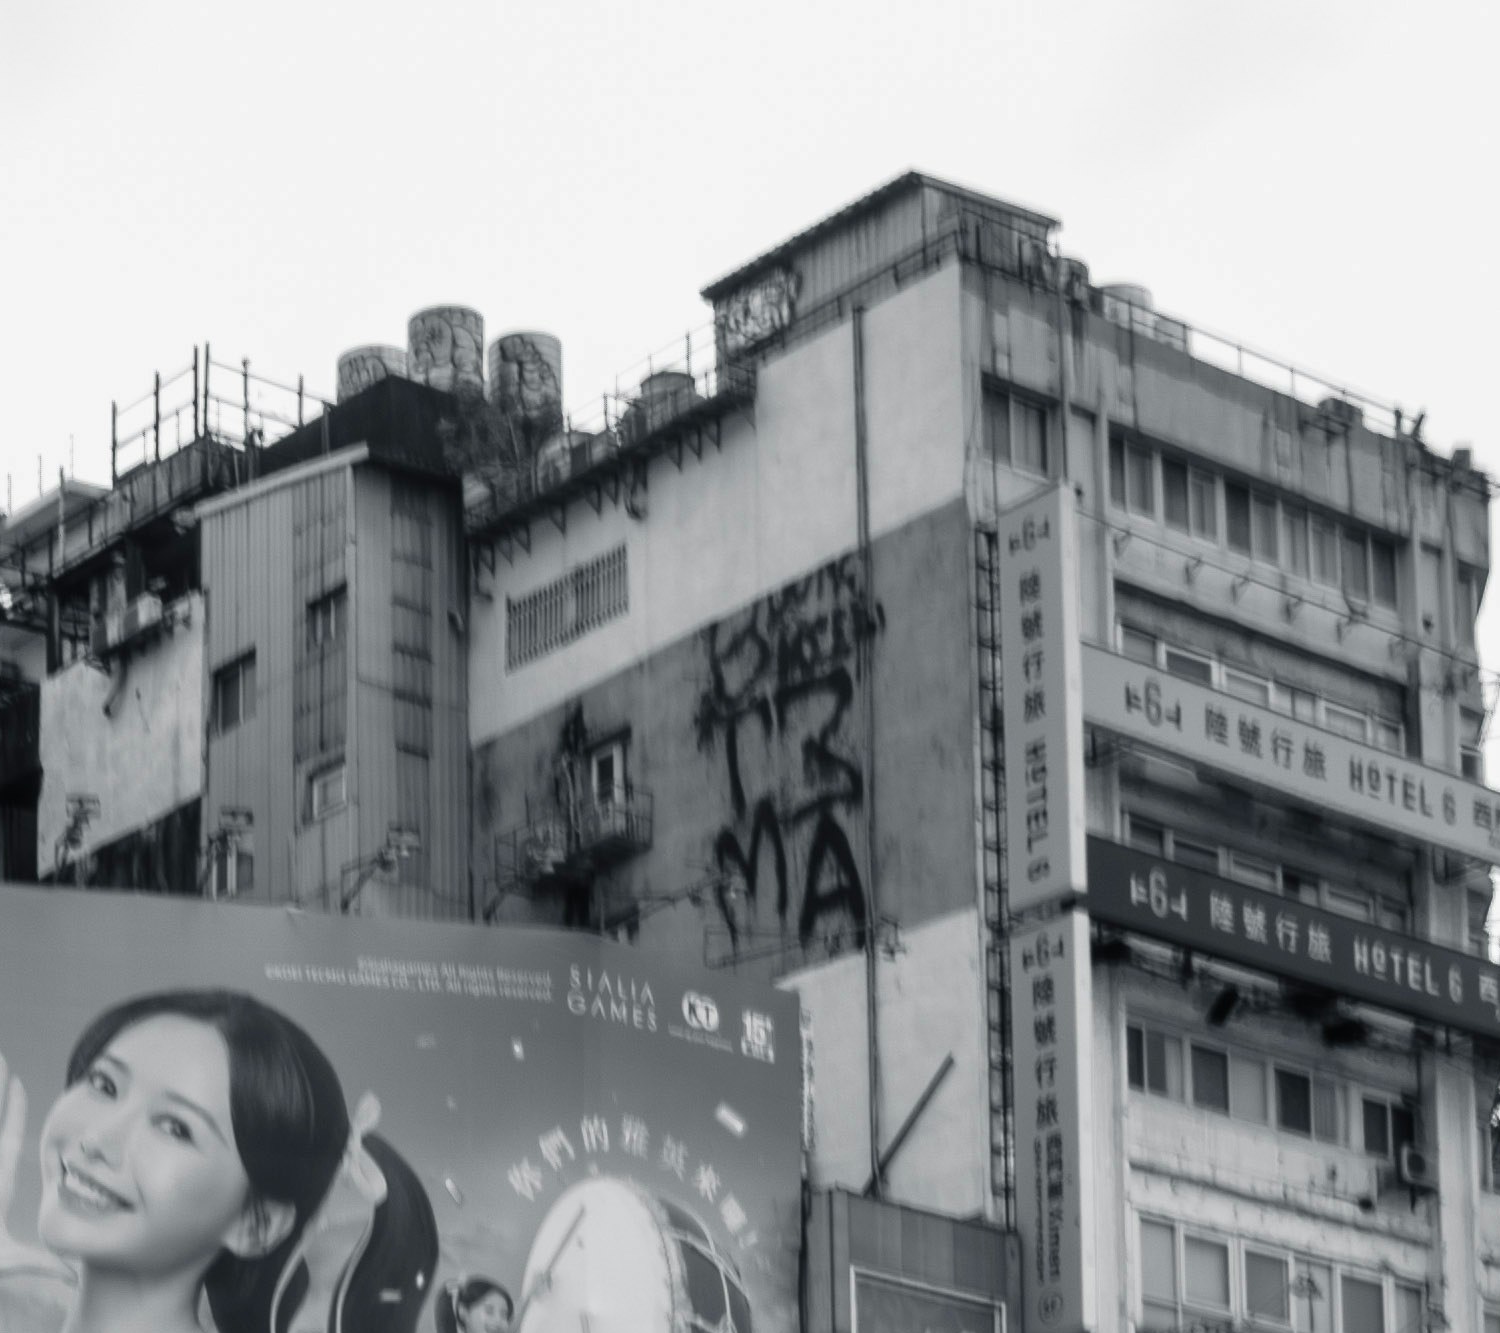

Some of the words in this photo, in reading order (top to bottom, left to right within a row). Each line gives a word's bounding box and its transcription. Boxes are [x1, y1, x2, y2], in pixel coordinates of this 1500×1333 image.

[1204, 701, 1328, 783] 陸號行旅
[1349, 752, 1435, 820] HOTEL
[1209, 887, 1333, 965] 陸號行旅
[570, 963, 656, 1005] SIALIA
[1353, 934, 1442, 998] HOTEL
[566, 991, 659, 1034] GAMES
